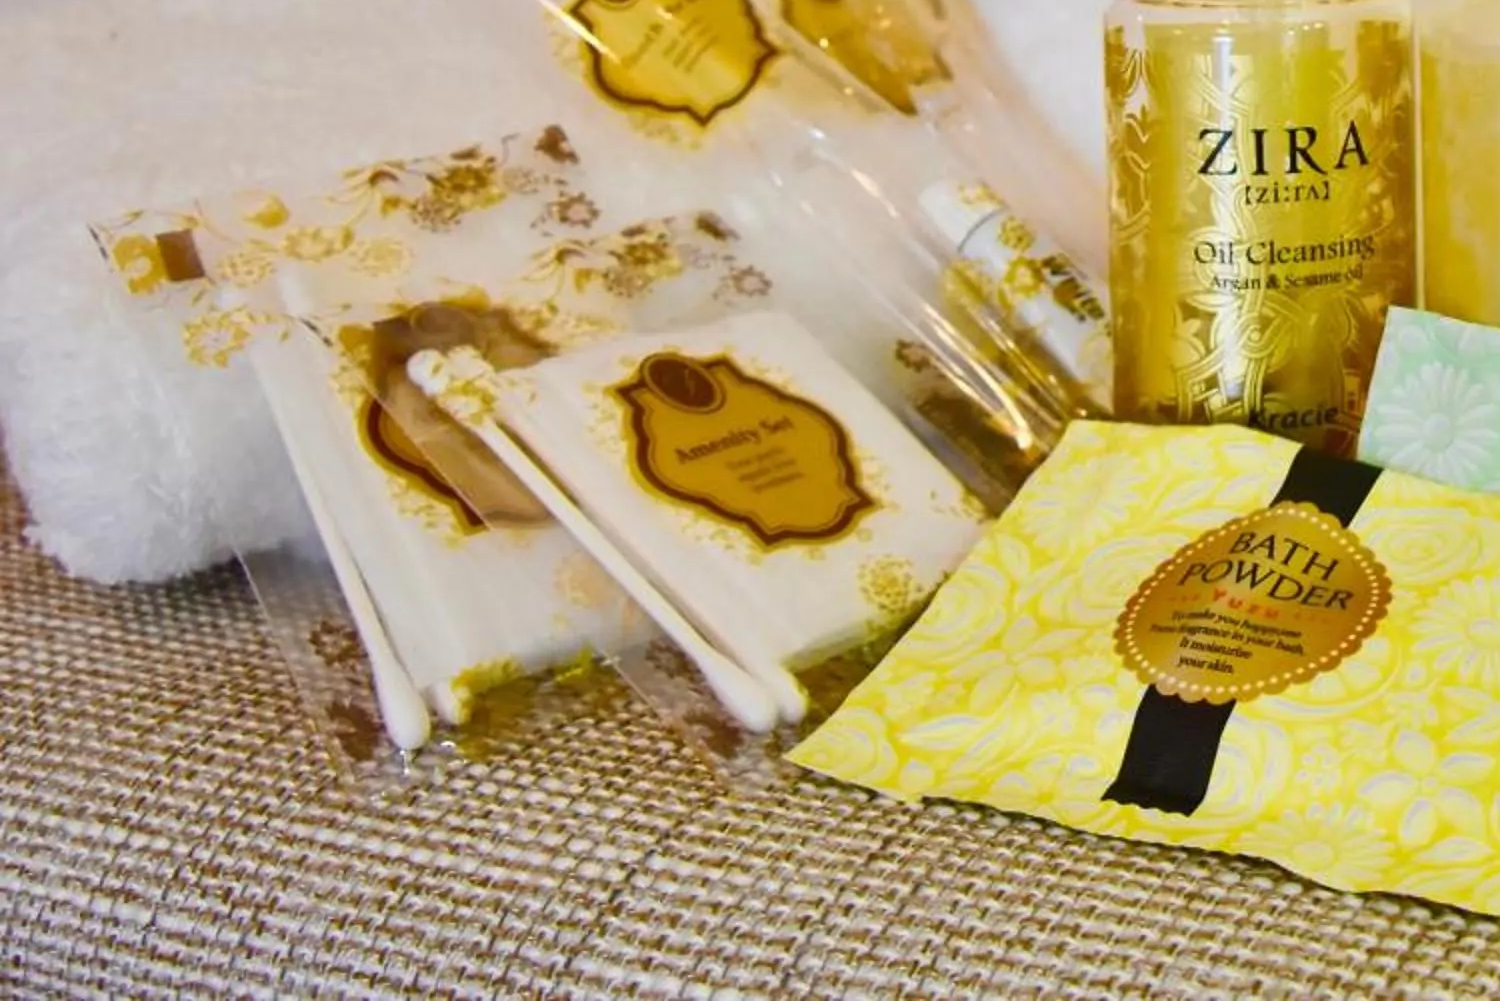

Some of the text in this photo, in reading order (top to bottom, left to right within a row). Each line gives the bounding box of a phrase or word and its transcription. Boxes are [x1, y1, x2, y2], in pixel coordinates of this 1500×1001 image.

[1197, 120, 1370, 176] ZIRA
[1194, 234, 1376, 267] Oil Cleansing
[1210, 274, 1262, 291] Argan
[1265, 274, 1281, 290] &
[1229, 531, 1340, 582] BATH
[1177, 559, 1356, 611] POWDER
